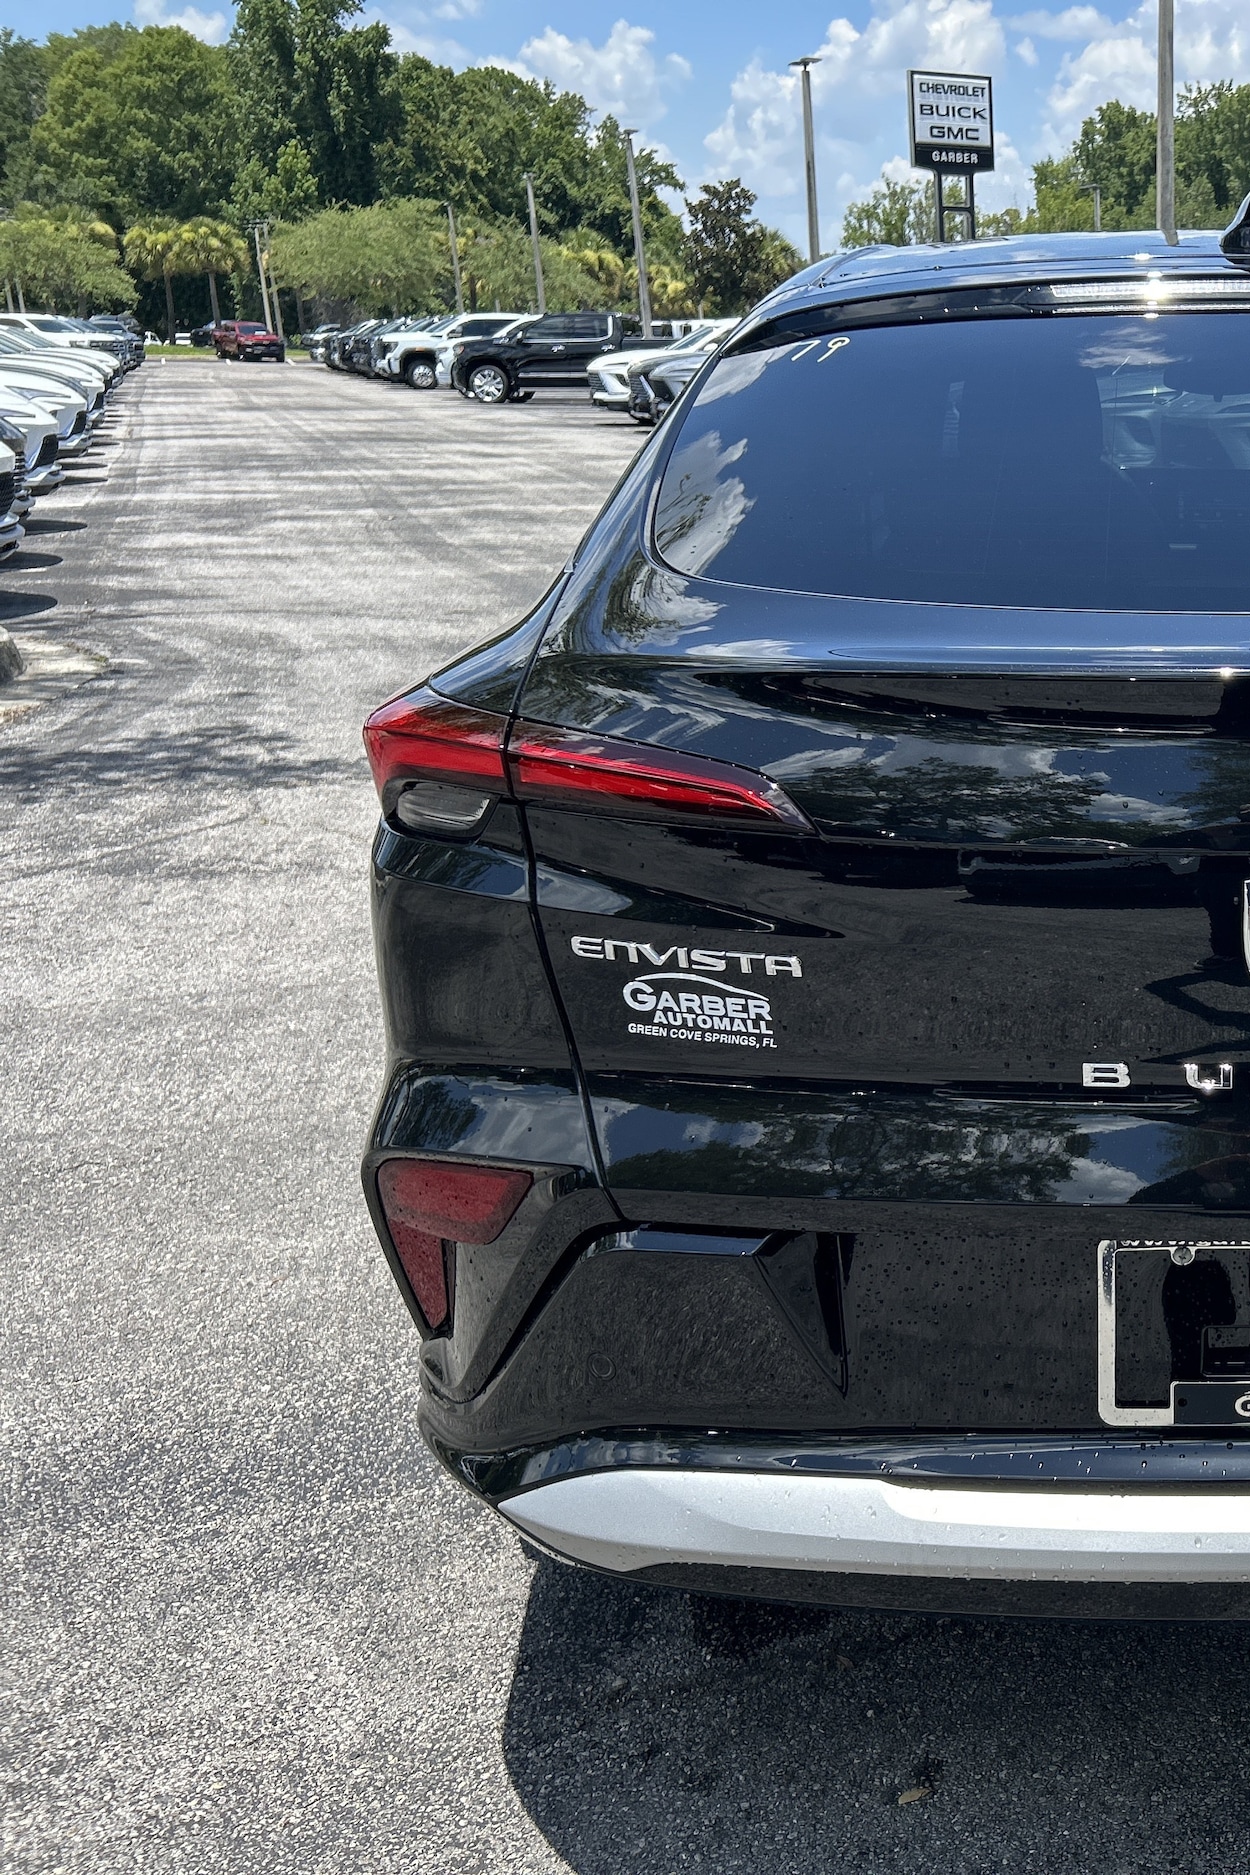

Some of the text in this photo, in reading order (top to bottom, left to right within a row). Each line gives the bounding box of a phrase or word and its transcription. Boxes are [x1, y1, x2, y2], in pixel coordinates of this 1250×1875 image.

[919, 82, 986, 97] CHEVROLET
[919, 104, 987, 120] BUICK
[929, 125, 980, 141] GMC
[931, 150, 979, 164] GARBER
[570, 935, 803, 978] ENVISTA
[622, 981, 773, 1021] GARBER
[653, 1008, 774, 1035] AUTOMALL
[627, 1023, 778, 1049] GREEN COVE SPRINGS, FL
